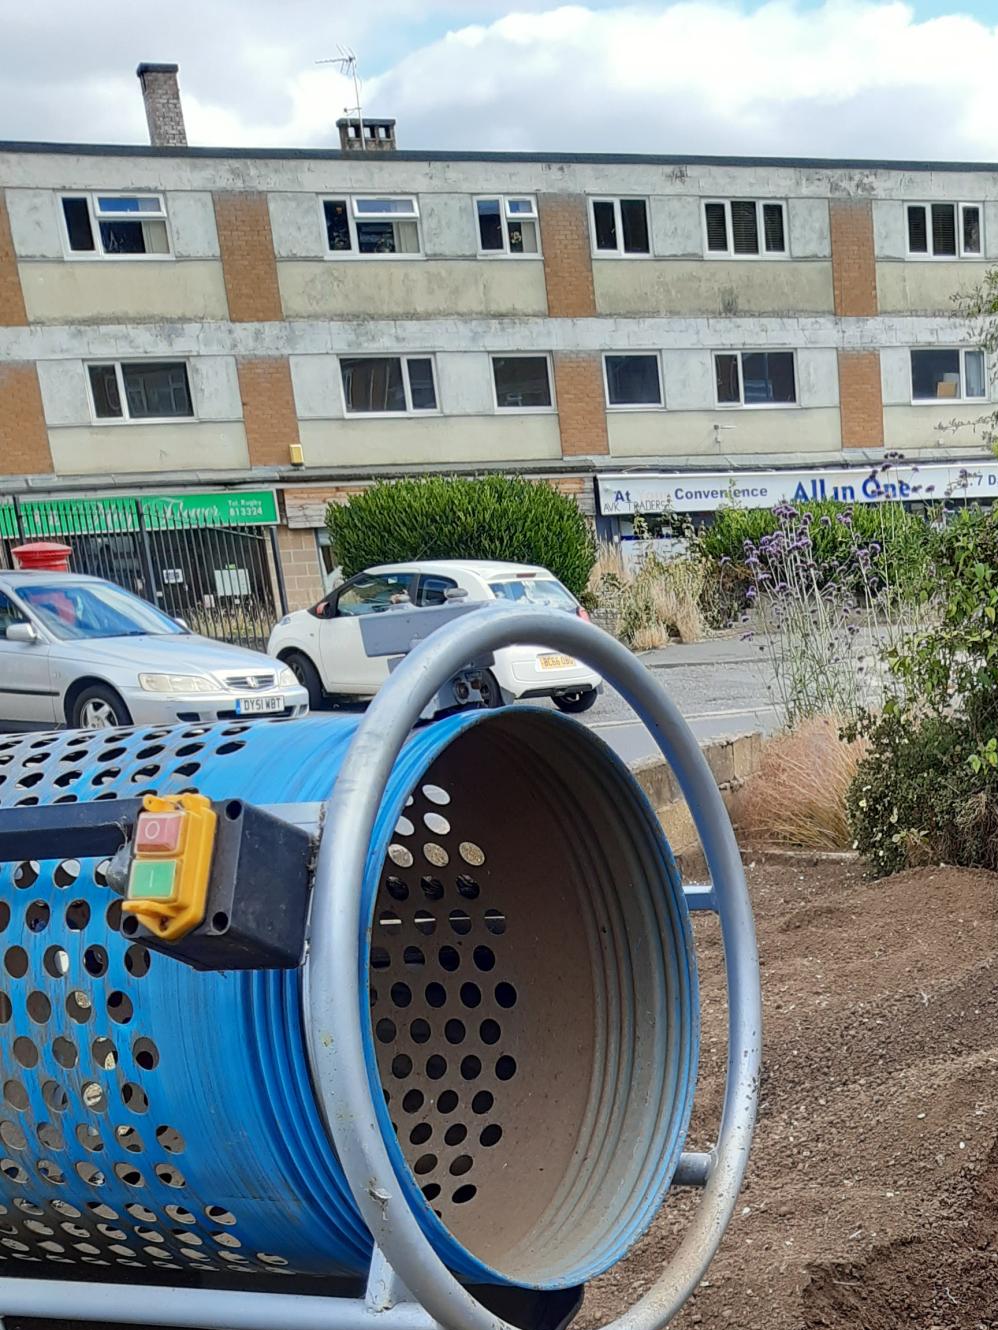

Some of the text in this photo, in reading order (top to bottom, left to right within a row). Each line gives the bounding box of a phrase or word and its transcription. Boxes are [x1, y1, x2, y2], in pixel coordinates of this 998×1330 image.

[614, 490, 631, 502] At
[675, 487, 768, 500] Convenience
[793, 478, 911, 502] All in One
